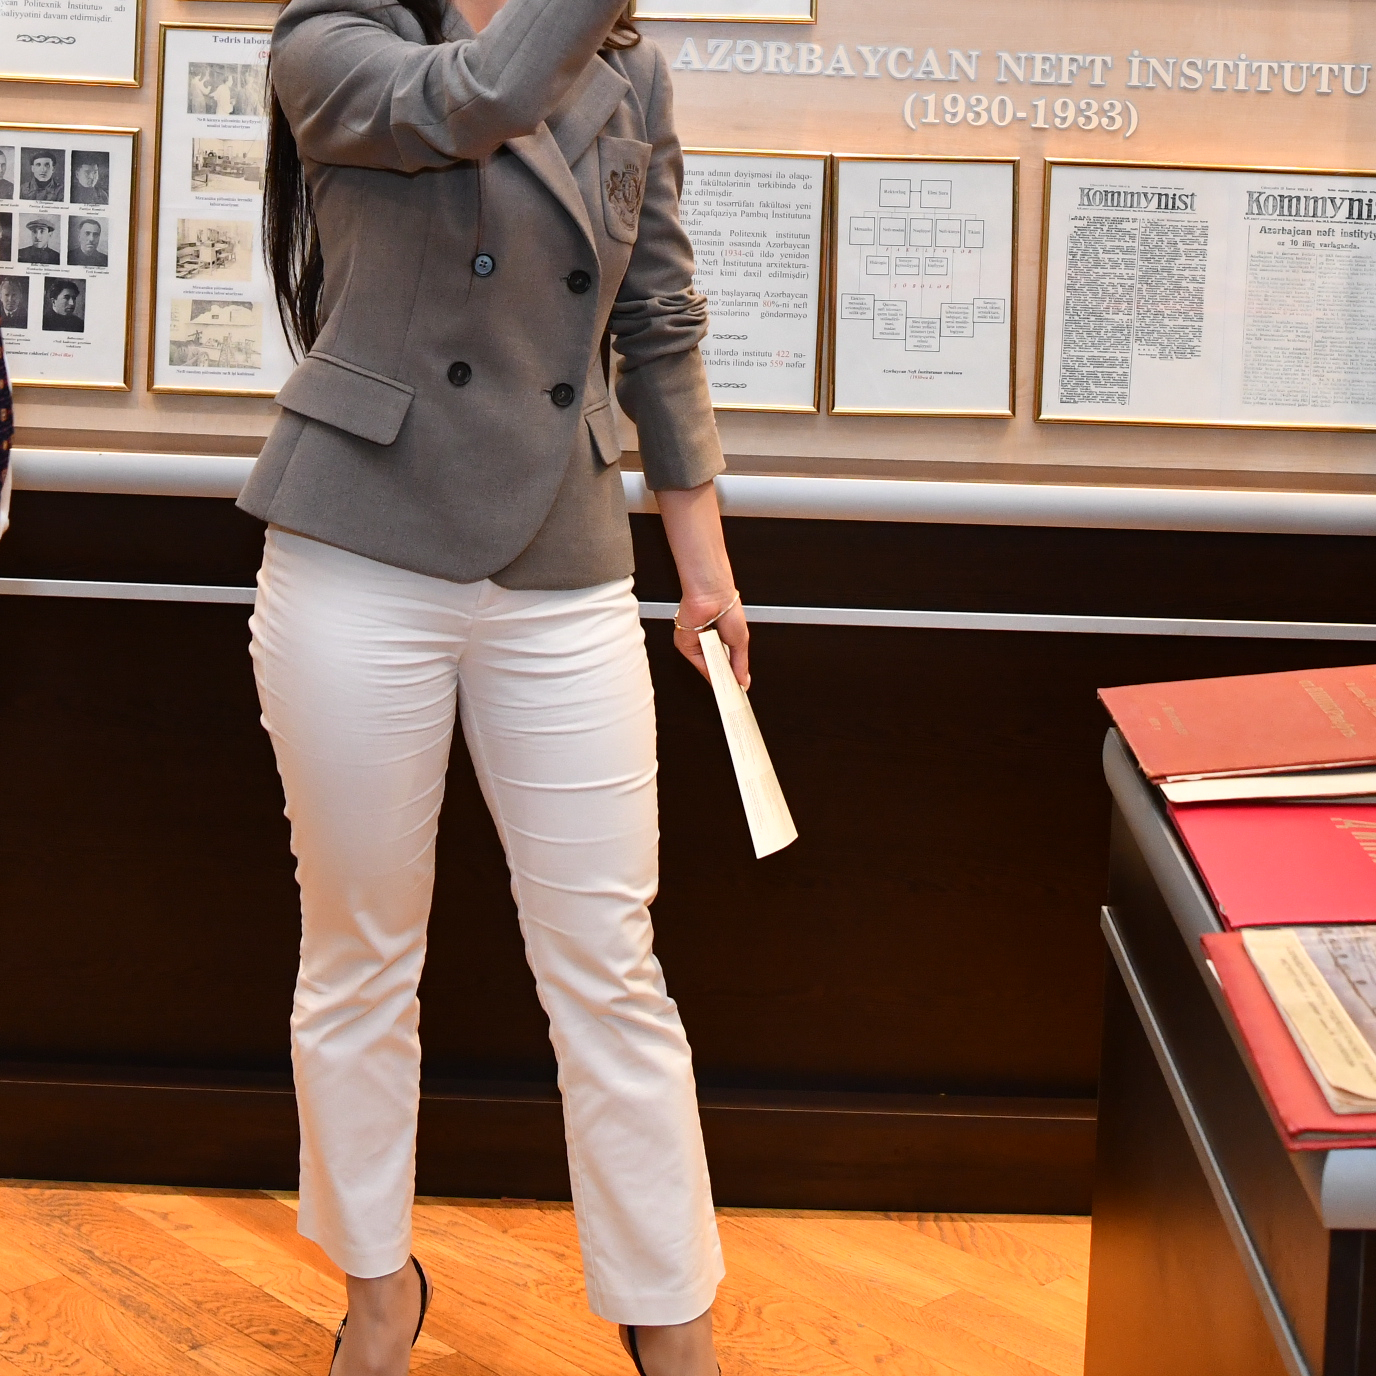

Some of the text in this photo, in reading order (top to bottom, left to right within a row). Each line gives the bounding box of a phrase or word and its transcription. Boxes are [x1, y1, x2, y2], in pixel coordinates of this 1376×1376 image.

[212, 35, 241, 44] Tədris
[674, 36, 1373, 95] AZƏRBAYCAN NEFT İNSTİTUTU
[903, 92, 1140, 138] (1930-1933)
[1078, 187, 1197, 213] Kommynist
[688, 229, 811, 240] zamanda Politexnik institutun
[1290, 239, 1299, 247] 10
[720, 249, 810, 260] (1934-cü ildə yenidən
[709, 358, 731, 366] tədris
[732, 359, 754, 367] ilində
[770, 360, 784, 368] 559
